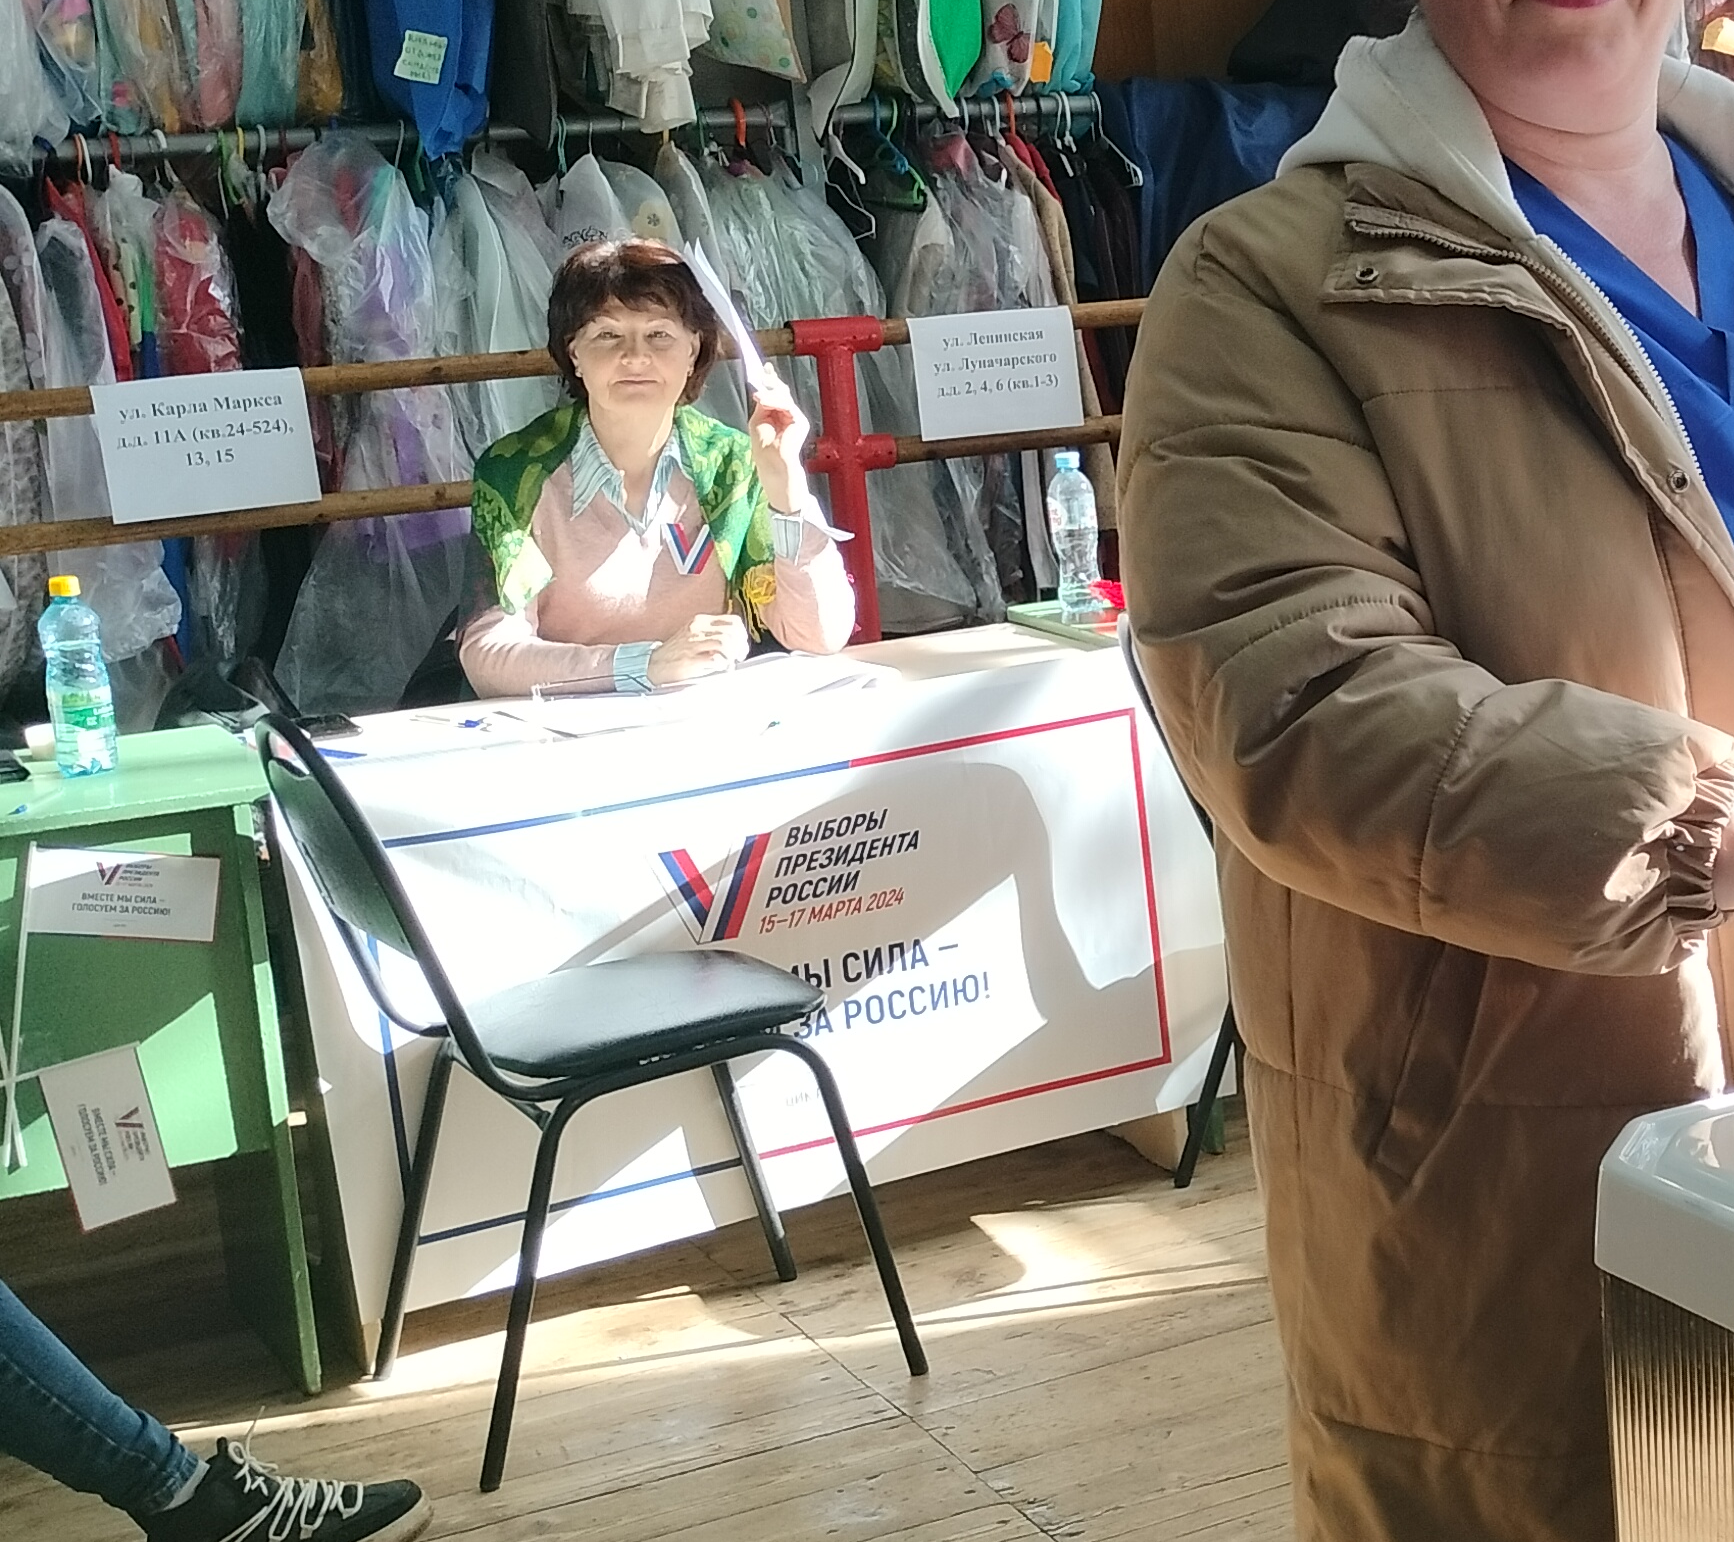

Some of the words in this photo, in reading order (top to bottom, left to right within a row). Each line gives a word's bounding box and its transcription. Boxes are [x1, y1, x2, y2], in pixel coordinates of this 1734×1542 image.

[942, 337, 964, 351] ул.
[967, 329, 1044, 346] Ленинская
[933, 362, 955, 376] ул.
[958, 352, 1057, 373] Луначарского
[965, 381, 977, 395] 2,
[980, 380, 993, 394] 4,
[996, 379, 1004, 392] 6
[119, 408, 147, 425] ул.
[151, 402, 208, 419] Карла
[213, 395, 283, 412] Маркса
[154, 429, 187, 445] 11А
[186, 451, 210, 467] 13,
[216, 448, 235, 463] 15
[784, 808, 889, 849] ВЫБОРЫ
[774, 829, 921, 878] ПРЕЗИДЕНТА
[82, 892, 114, 902] ВМЕСТЕ
[117, 894, 132, 903] МЫ
[134, 895, 157, 904] СИЛА
[765, 870, 861, 908] РОССИИ
[72, 903, 117, 913] ГОЛОСУЕМ
[119, 904, 129, 914] ЗА
[807, 896, 862, 925] МАРТА
[866, 887, 905, 912] 2024
[842, 938, 929, 983] СИЛА
[794, 1007, 834, 1040] ЗА
[844, 971, 992, 1030] РОССИЮ!
